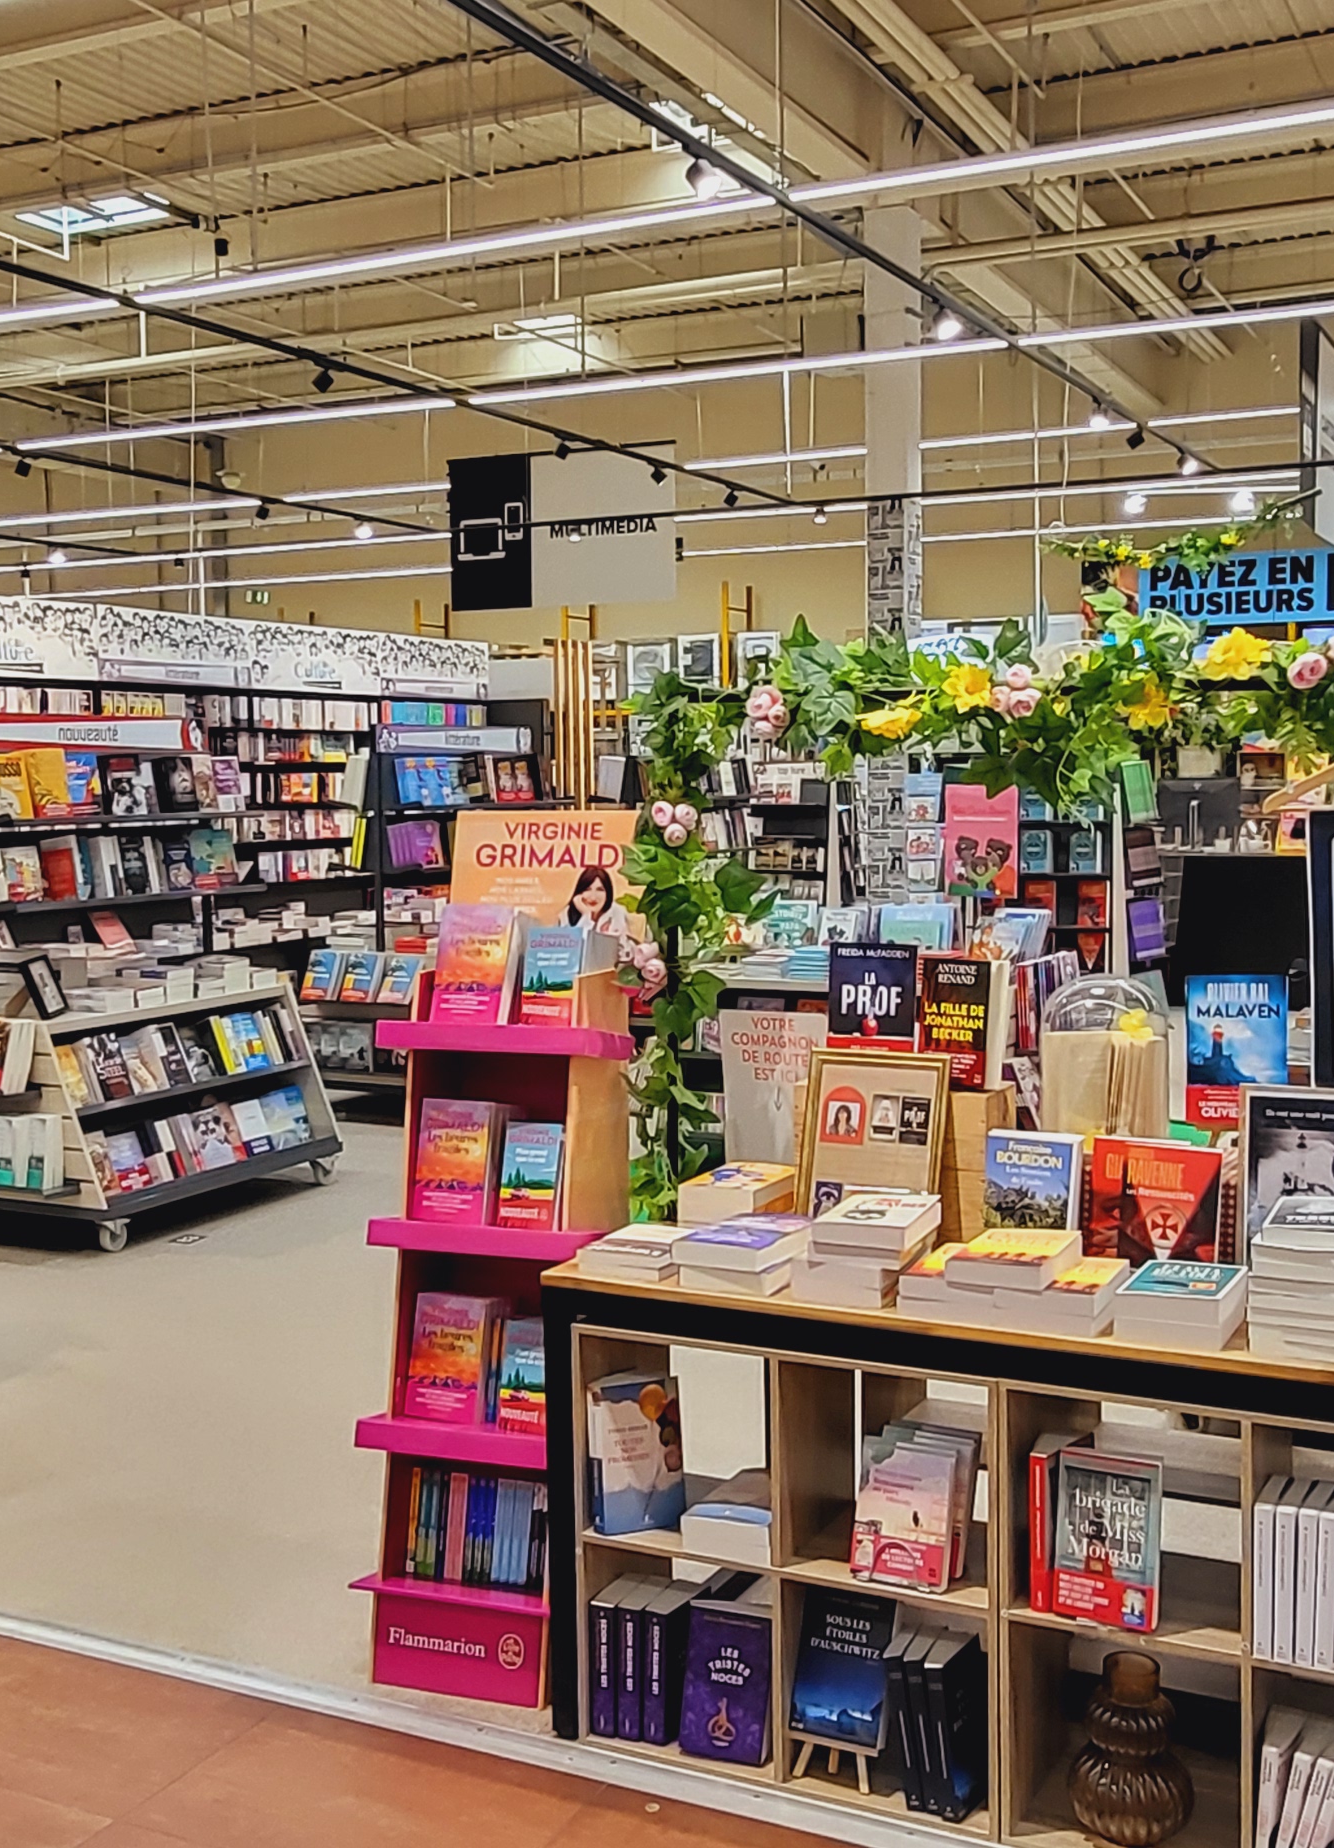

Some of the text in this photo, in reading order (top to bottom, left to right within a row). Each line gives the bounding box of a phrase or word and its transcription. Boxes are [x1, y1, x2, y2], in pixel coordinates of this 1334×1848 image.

[1150, 555, 1314, 592] PAYEZ EN
[1150, 588, 1315, 617] PLUSIEURS
[58, 725, 119, 743] nouveauté
[504, 822, 604, 841] VIRGINIE
[837, 947, 864, 957] FREIDA
[937, 963, 978, 975] ANTOINE
[864, 972, 876, 985] LA
[937, 974, 976, 986] RENAND
[841, 984, 903, 1017] PROF
[1207, 983, 1269, 1002] OLIVIER BAL
[924, 1001, 985, 1018] LA FILLE DE
[1197, 1003, 1280, 1019] MALAVEN
[751, 1017, 796, 1032] VOTRE
[924, 1015, 984, 1030] JONATHAN
[731, 1032, 819, 1050] COMPAGNON
[932, 1027, 973, 1042] BECKER
[742, 1049, 809, 1068] DE ROUTE
[754, 1067, 798, 1084] EST ICI
[1201, 1107, 1239, 1118] OLIVIE
[996, 1150, 1063, 1170] BOURDON
[1127, 1158, 1185, 1188] RAVENNE
[1112, 1479, 1131, 1496] La
[1072, 1487, 1147, 1518] brigade
[1079, 1519, 1146, 1543] de Miss
[1067, 1535, 1143, 1568] Morgan
[826, 1613, 871, 1632] SOUS LES
[387, 1627, 486, 1658] Flammarion
[825, 1626, 868, 1644] ÉTOILES
[720, 1647, 739, 1659] LES
[810, 1637, 881, 1660] D'AUSCHWITZ
[707, 1659, 751, 1678] TRISTES
[710, 1672, 744, 1686] NOCES
